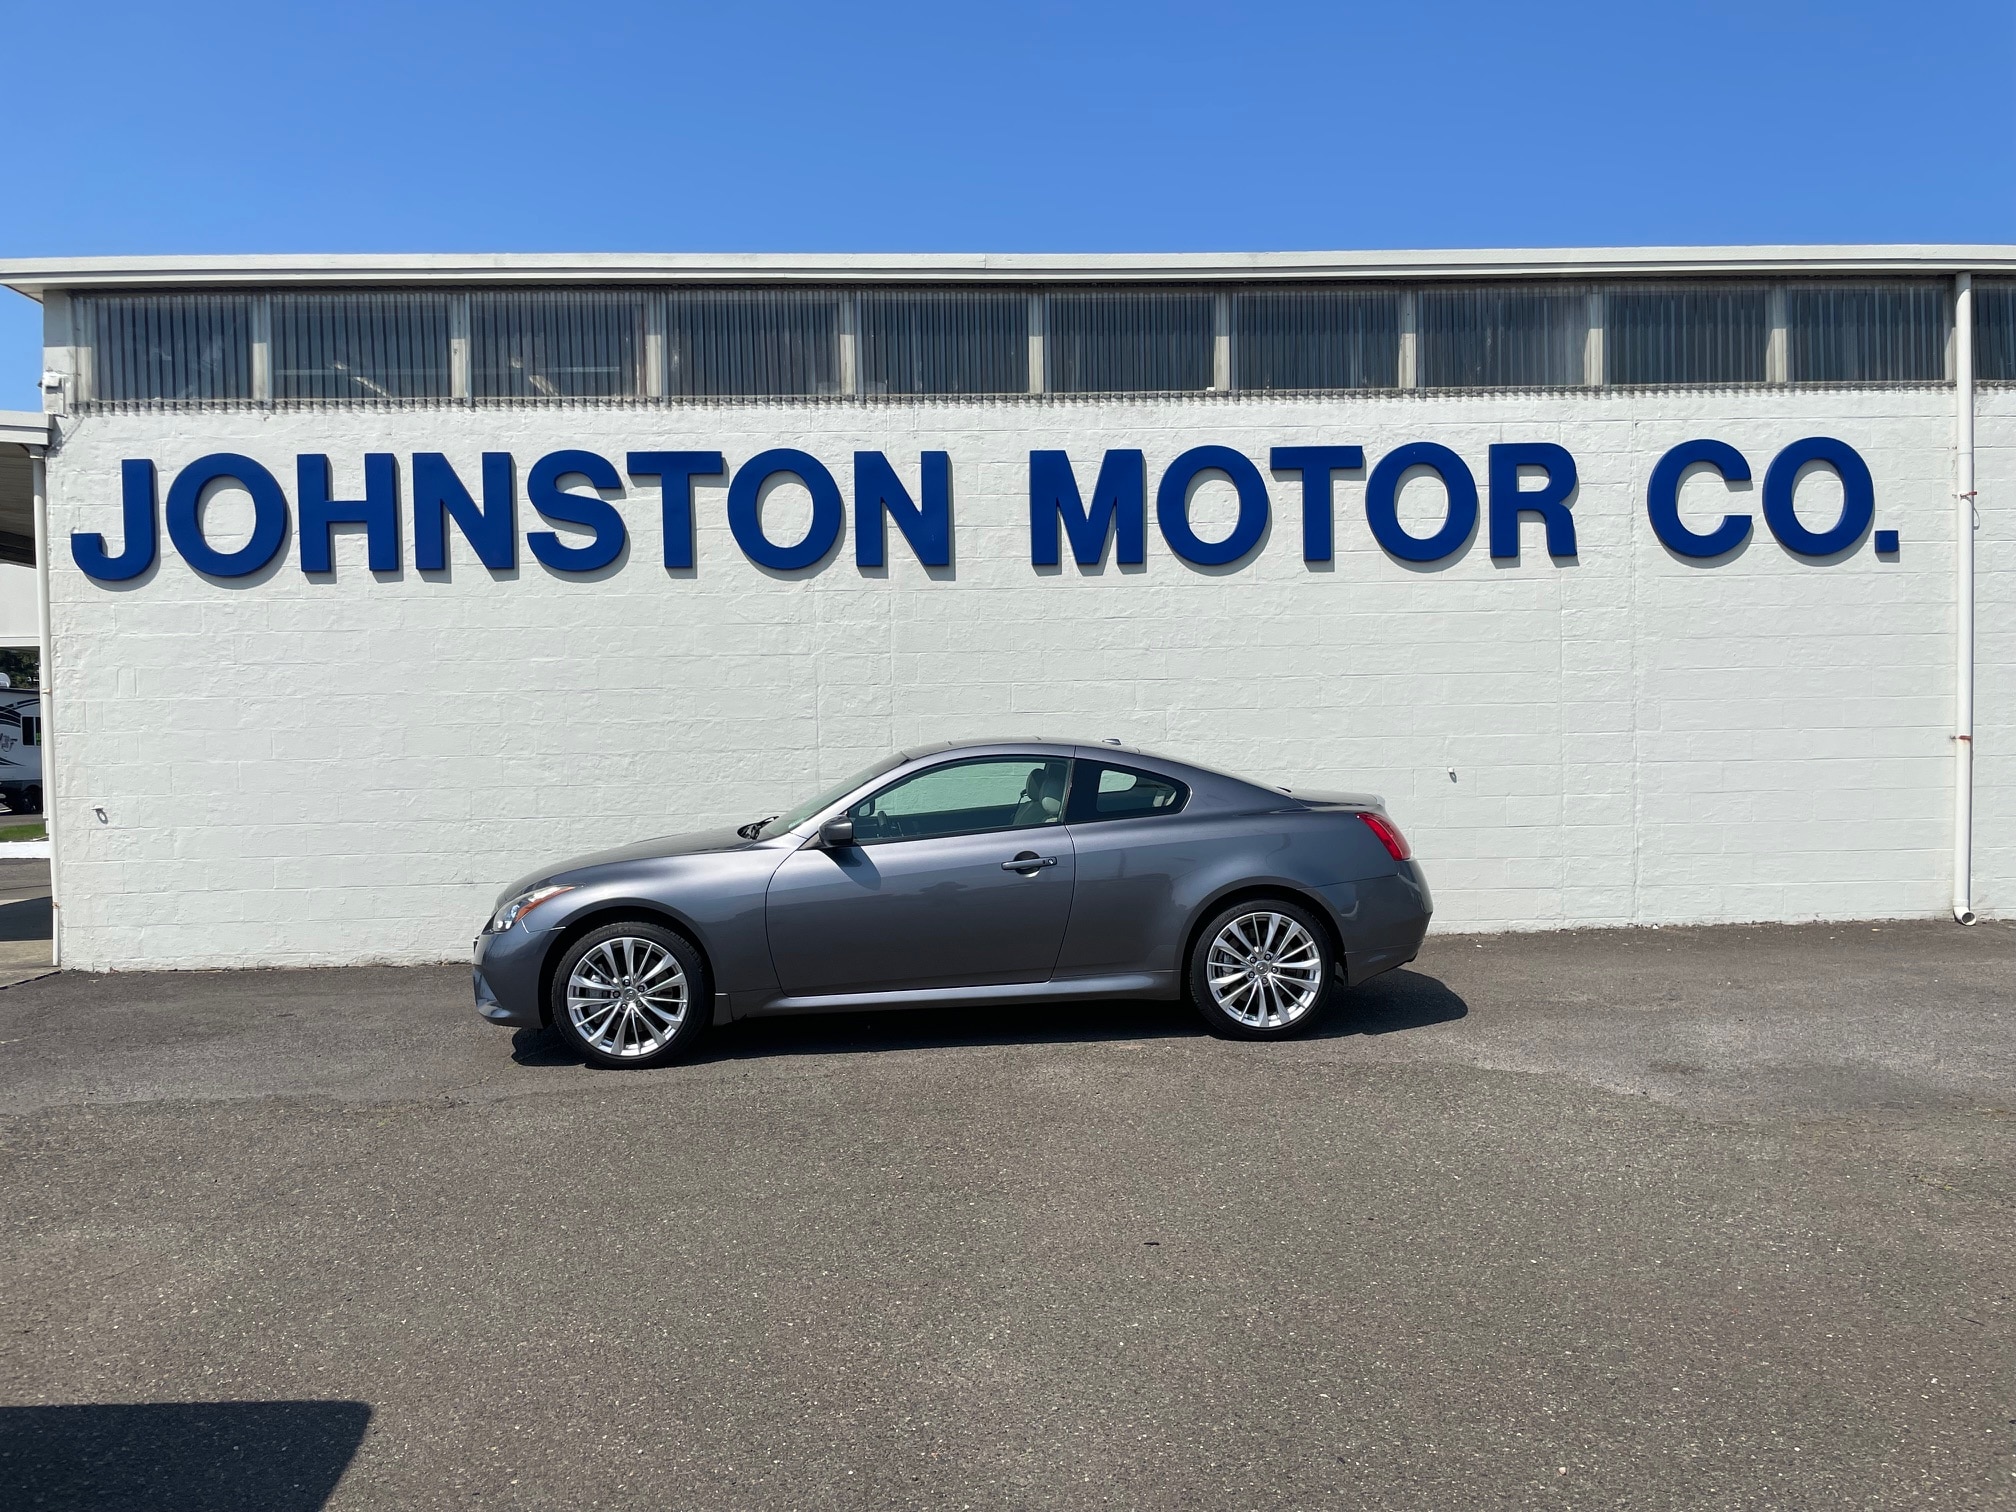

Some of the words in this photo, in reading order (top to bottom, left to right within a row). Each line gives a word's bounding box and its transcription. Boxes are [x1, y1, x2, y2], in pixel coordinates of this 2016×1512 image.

[71, 448, 951, 582] JOHNSTON
[1029, 442, 1578, 567] MOTOR
[1648, 437, 1899, 558] CO.
